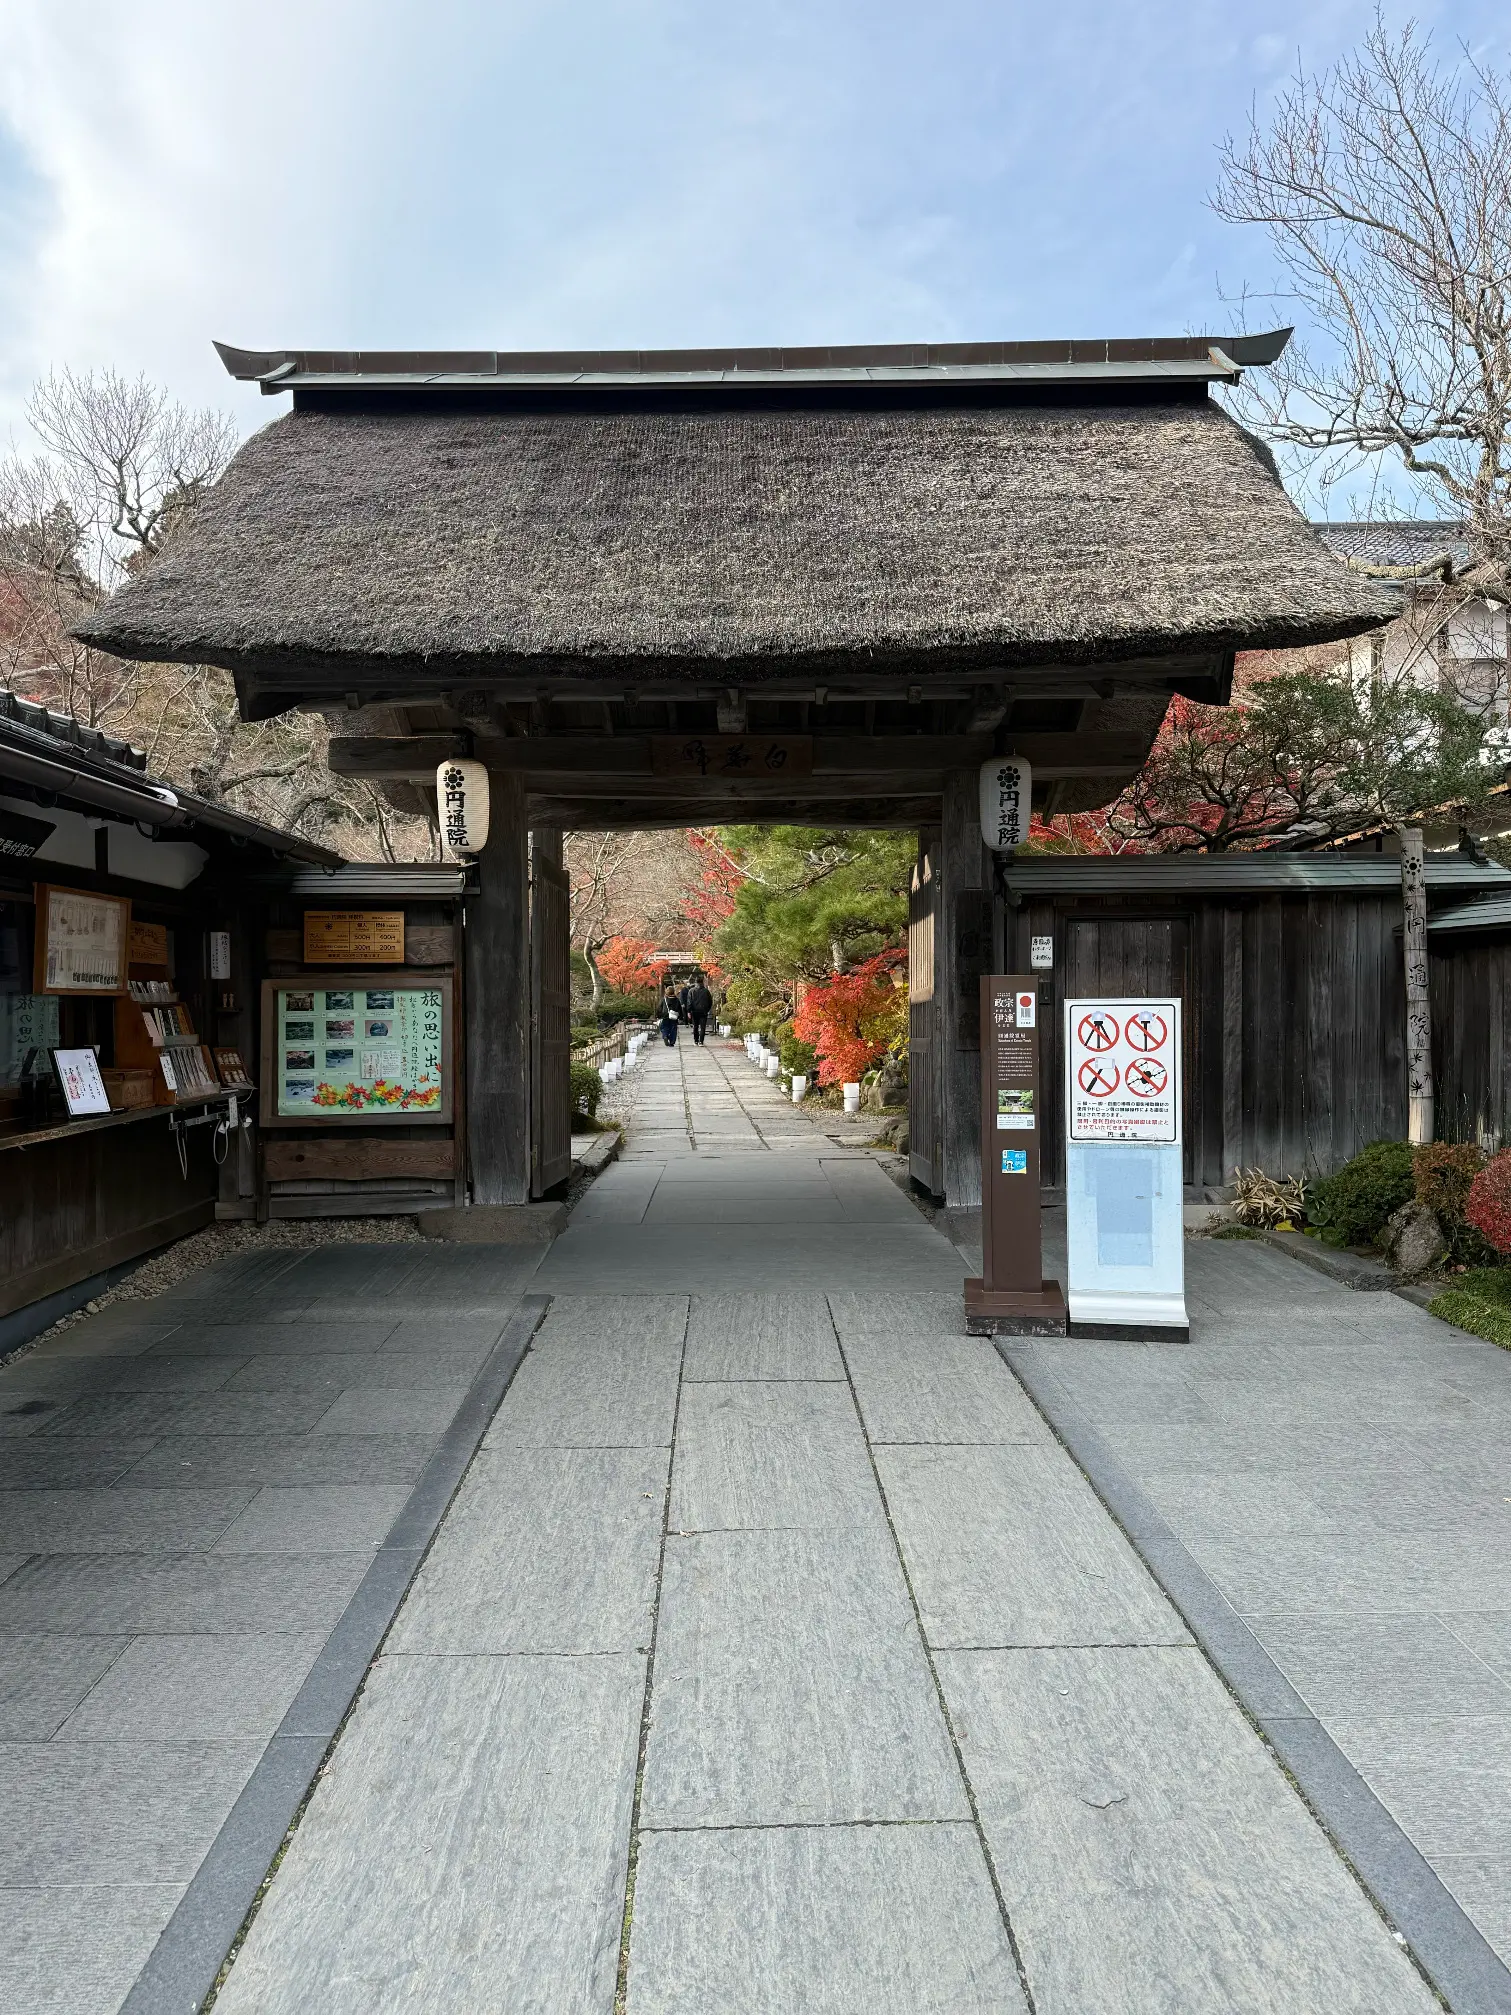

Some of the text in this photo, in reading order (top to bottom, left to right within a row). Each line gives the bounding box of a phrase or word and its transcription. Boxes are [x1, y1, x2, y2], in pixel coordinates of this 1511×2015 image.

[445, 790, 470, 846] 円通院
[997, 790, 1021, 845] 円通院
[994, 998, 1014, 1008] 政宗
[1408, 916, 1430, 1035] 円通院
[420, 991, 443, 1082] 旅の思い出に
